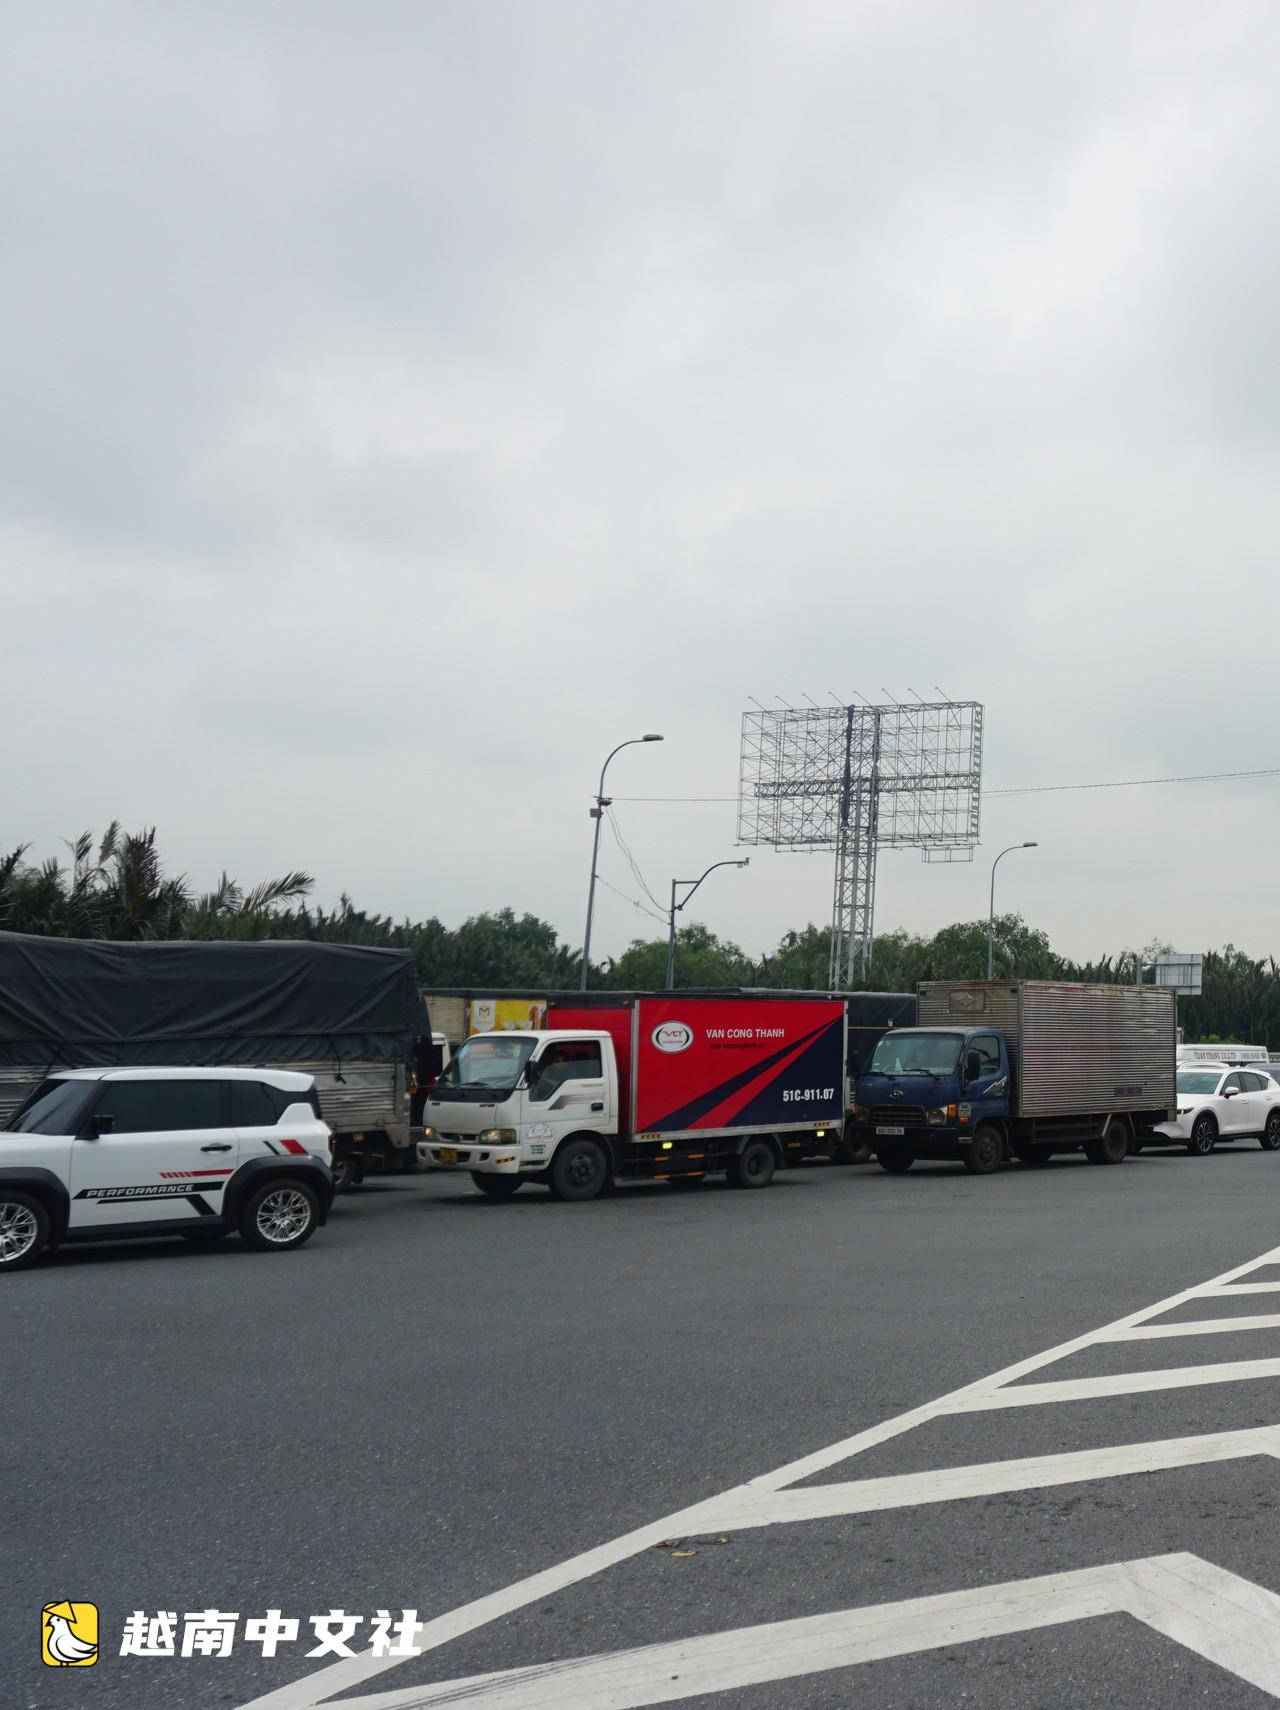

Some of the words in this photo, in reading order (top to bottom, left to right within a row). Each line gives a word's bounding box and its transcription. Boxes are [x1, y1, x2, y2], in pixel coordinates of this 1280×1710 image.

[706, 1028, 725, 1039] VAN
[727, 1028, 753, 1039] CONG
[755, 1028, 785, 1038] THANH
[782, 1087, 835, 1102] 51C-911.07
[86, 1184, 194, 1198] PERFORMANCE
